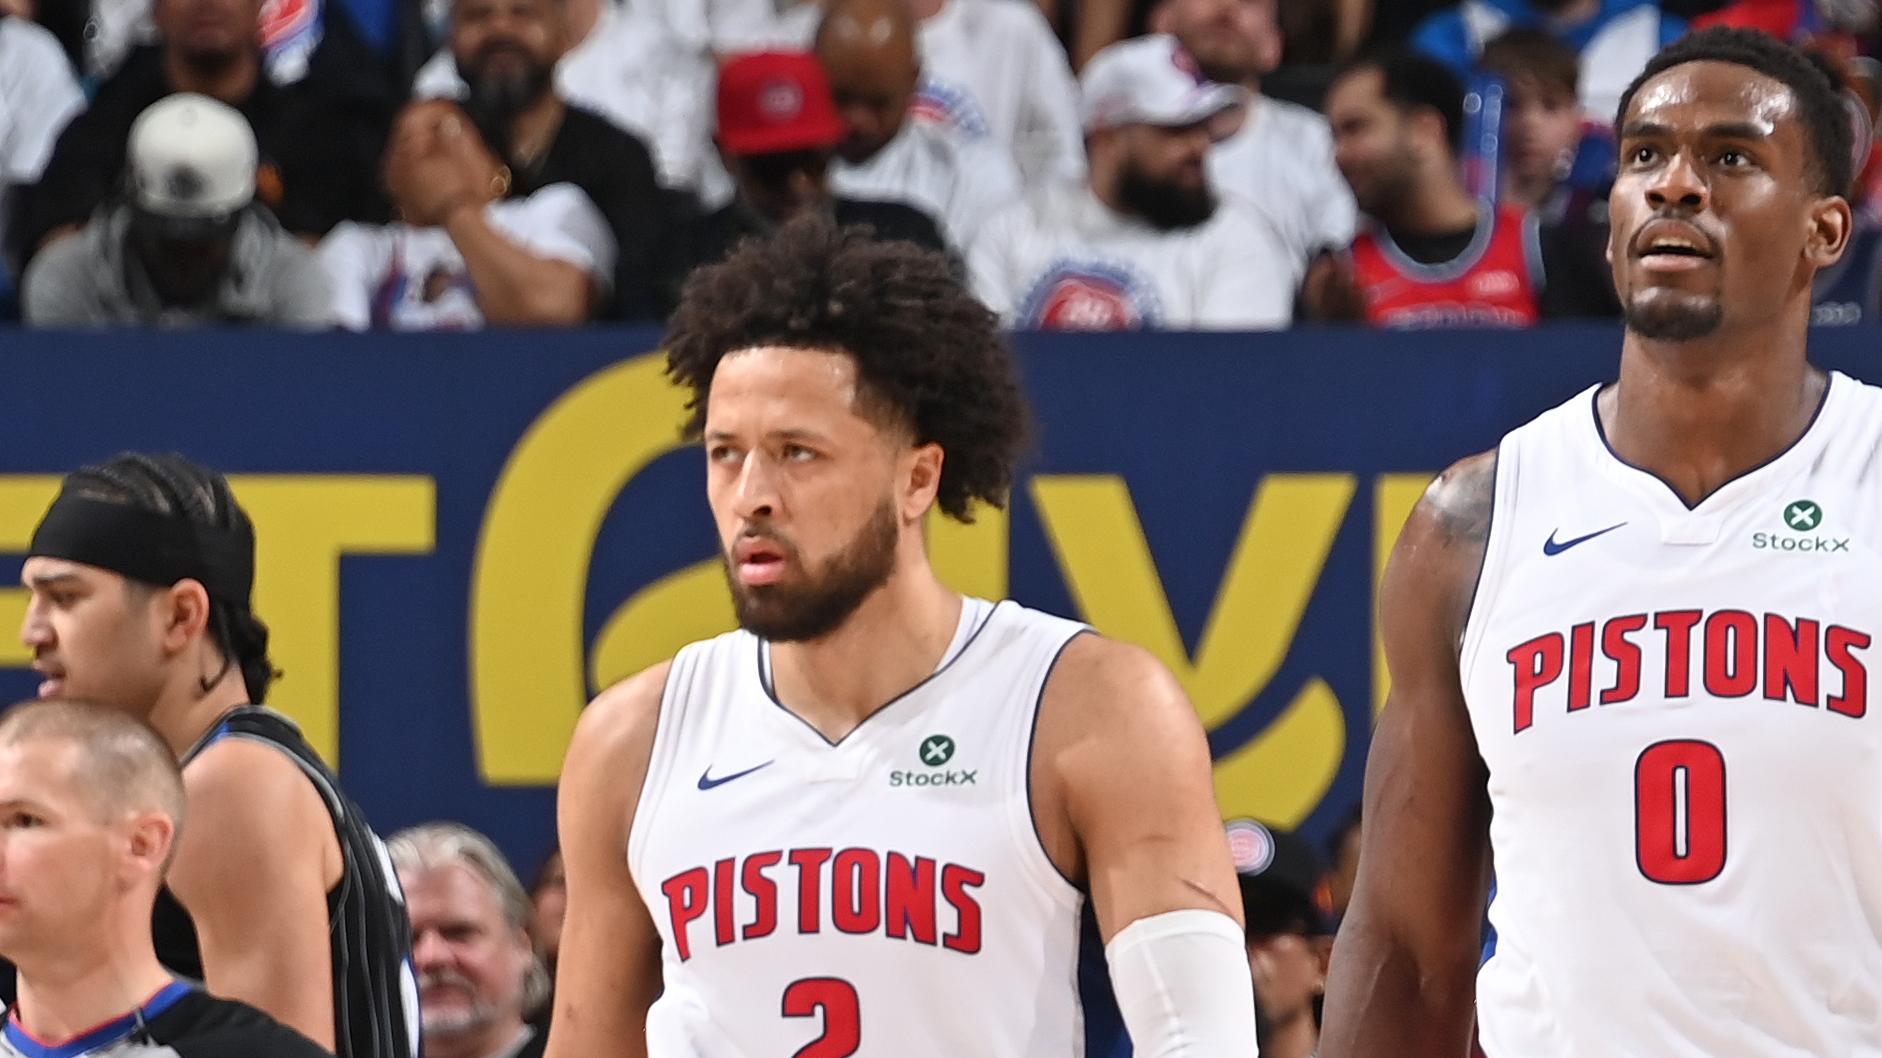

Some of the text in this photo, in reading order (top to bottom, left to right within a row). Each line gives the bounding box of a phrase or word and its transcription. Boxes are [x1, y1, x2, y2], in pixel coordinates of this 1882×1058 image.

[1752, 532, 1850, 552] StockX
[1506, 608, 1871, 734] PISTONS
[889, 769, 978, 787] StockX
[1634, 739, 1727, 885] 0
[661, 847, 985, 963] PISTONS
